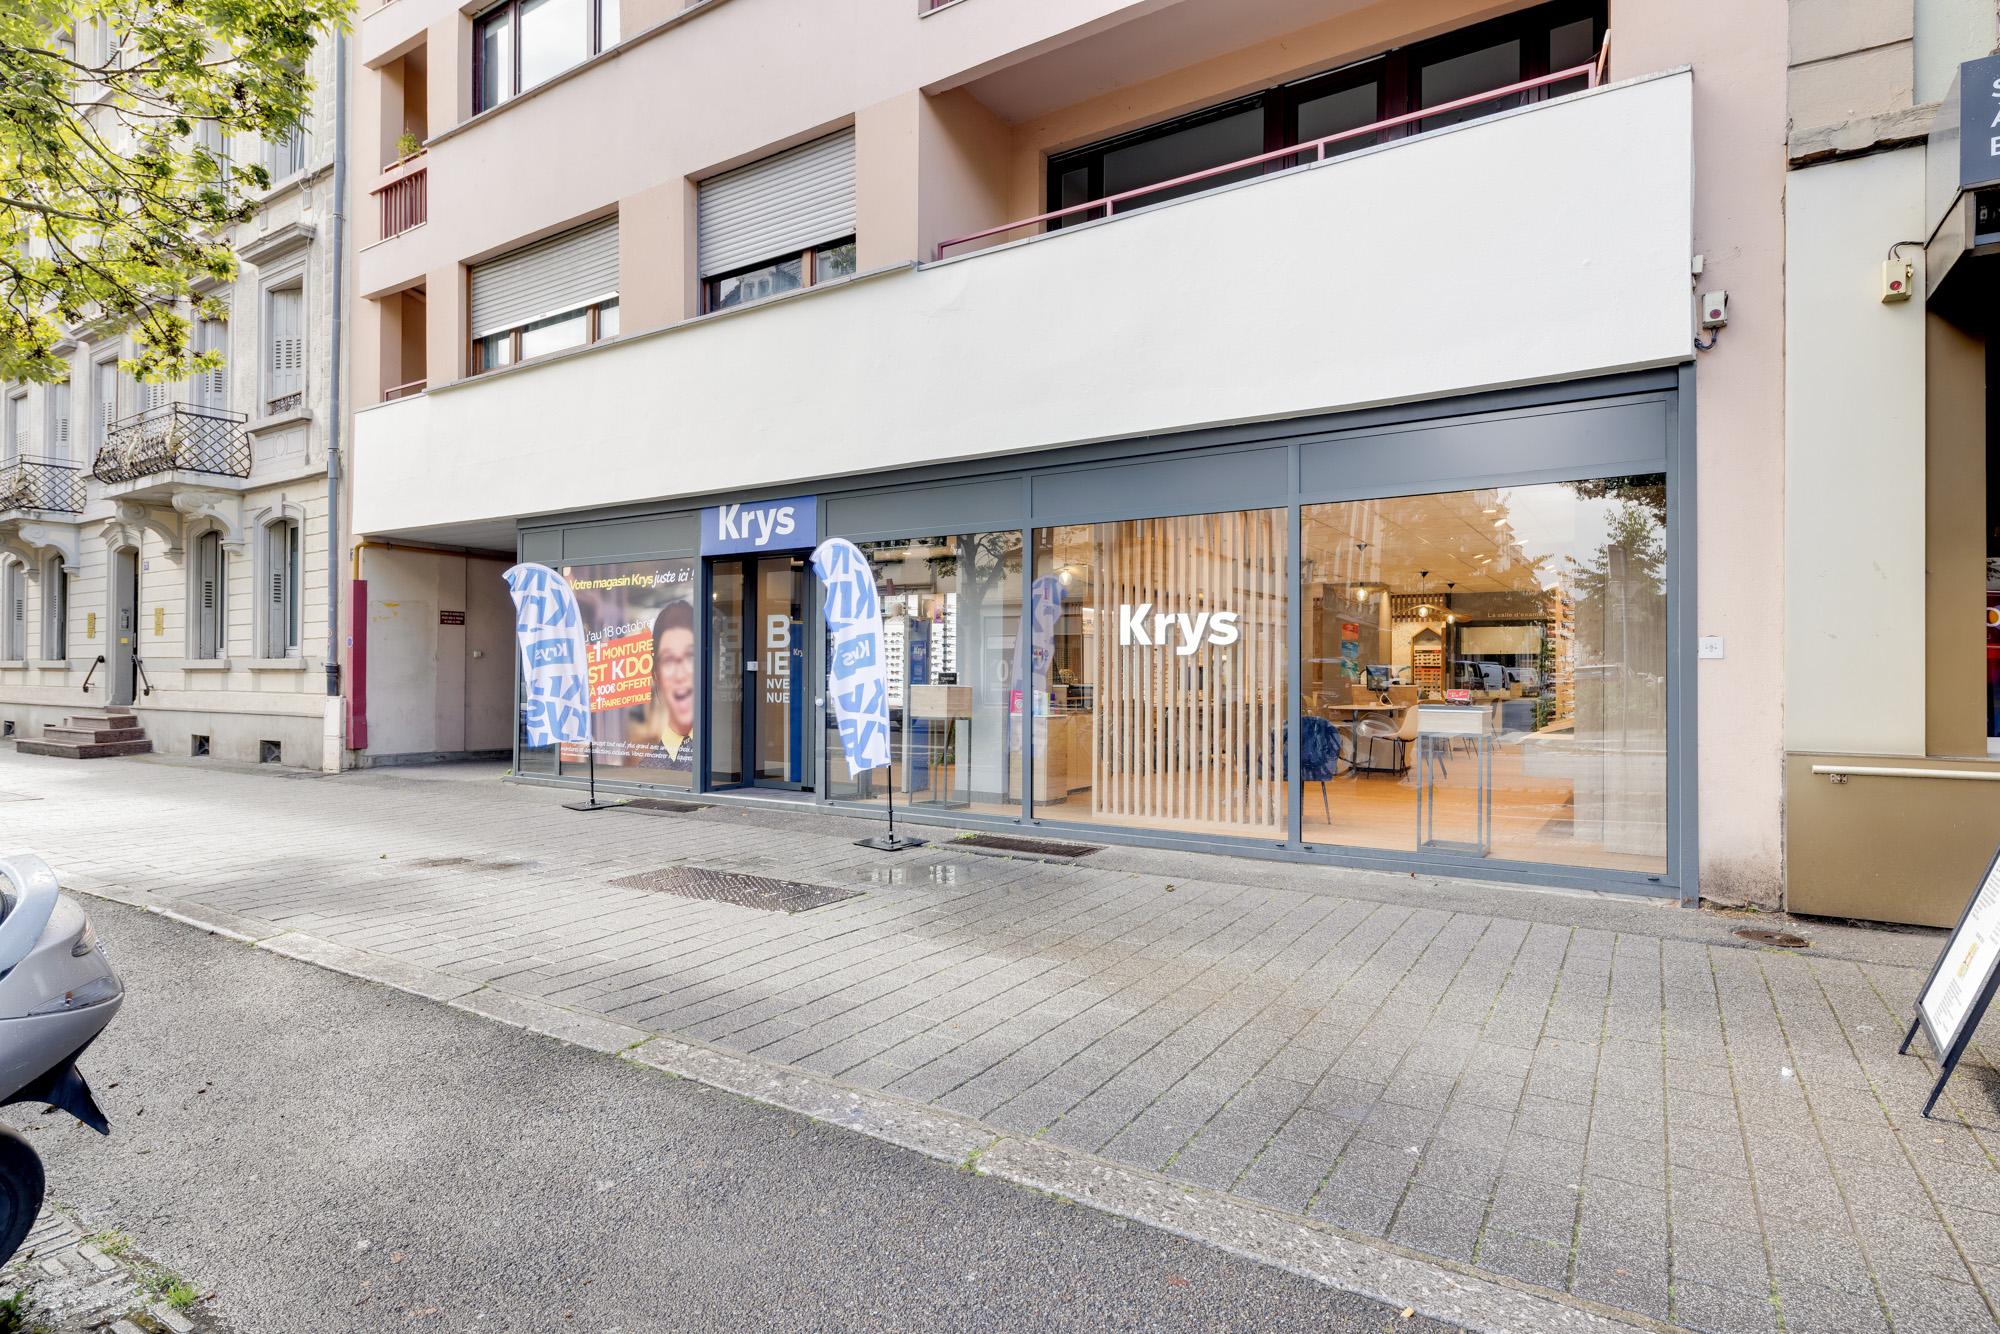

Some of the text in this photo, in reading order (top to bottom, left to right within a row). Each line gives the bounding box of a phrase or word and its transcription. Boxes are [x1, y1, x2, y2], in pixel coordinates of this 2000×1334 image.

[718, 503, 796, 546] Krys
[570, 579, 592, 590] Votre
[593, 575, 631, 590] magasin
[631, 573, 654, 588] Krys
[652, 570, 676, 588] juste
[678, 568, 690, 582] ici
[603, 626, 614, 638] 18
[1119, 603, 1239, 656] Krys
[602, 638, 654, 661] MONTURE
[602, 698, 622, 708] PAIRE
[622, 692, 652, 705] OPTIQUE
